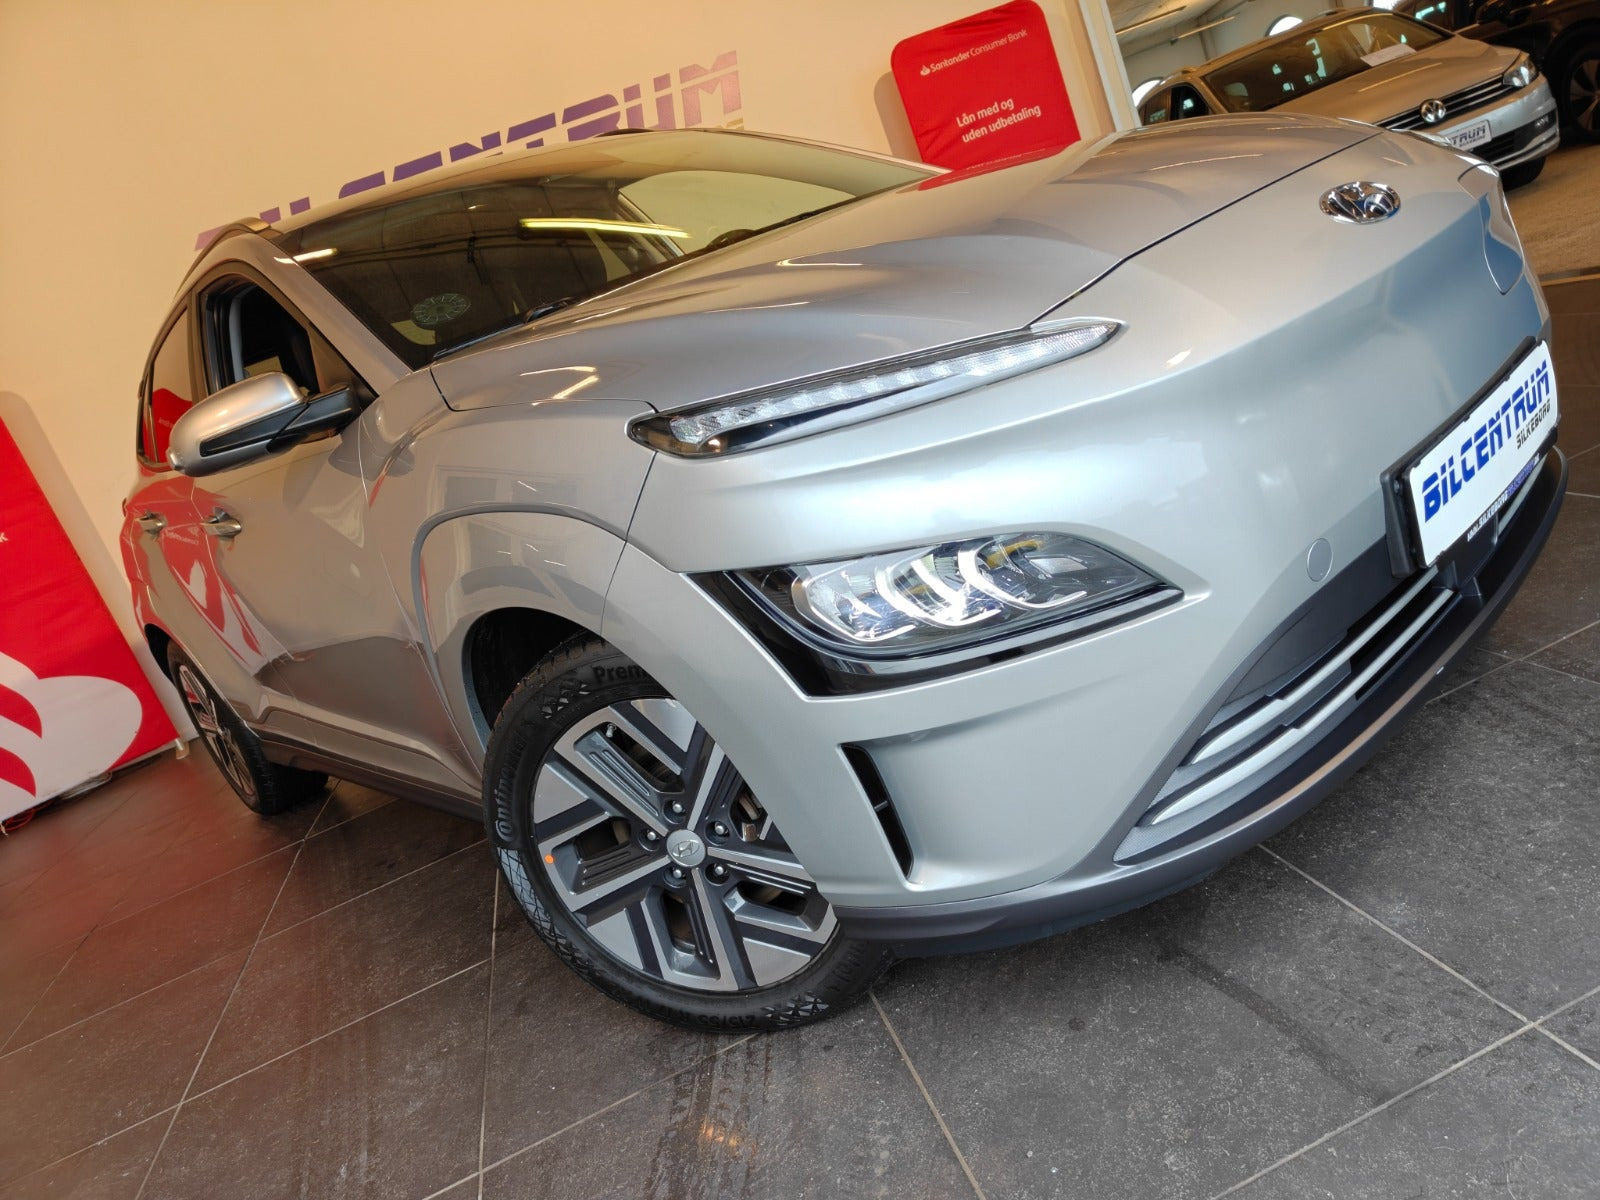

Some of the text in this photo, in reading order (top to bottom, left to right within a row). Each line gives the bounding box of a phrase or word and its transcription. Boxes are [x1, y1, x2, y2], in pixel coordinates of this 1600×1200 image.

[930, 28, 1028, 73] Santander Consumer Bank
[956, 98, 1014, 127] Lån med og
[962, 105, 1041, 143] uden udbetaling
[1421, 359, 1550, 524] BILCENTRUM
[1516, 398, 1551, 450] SILKEBORG
